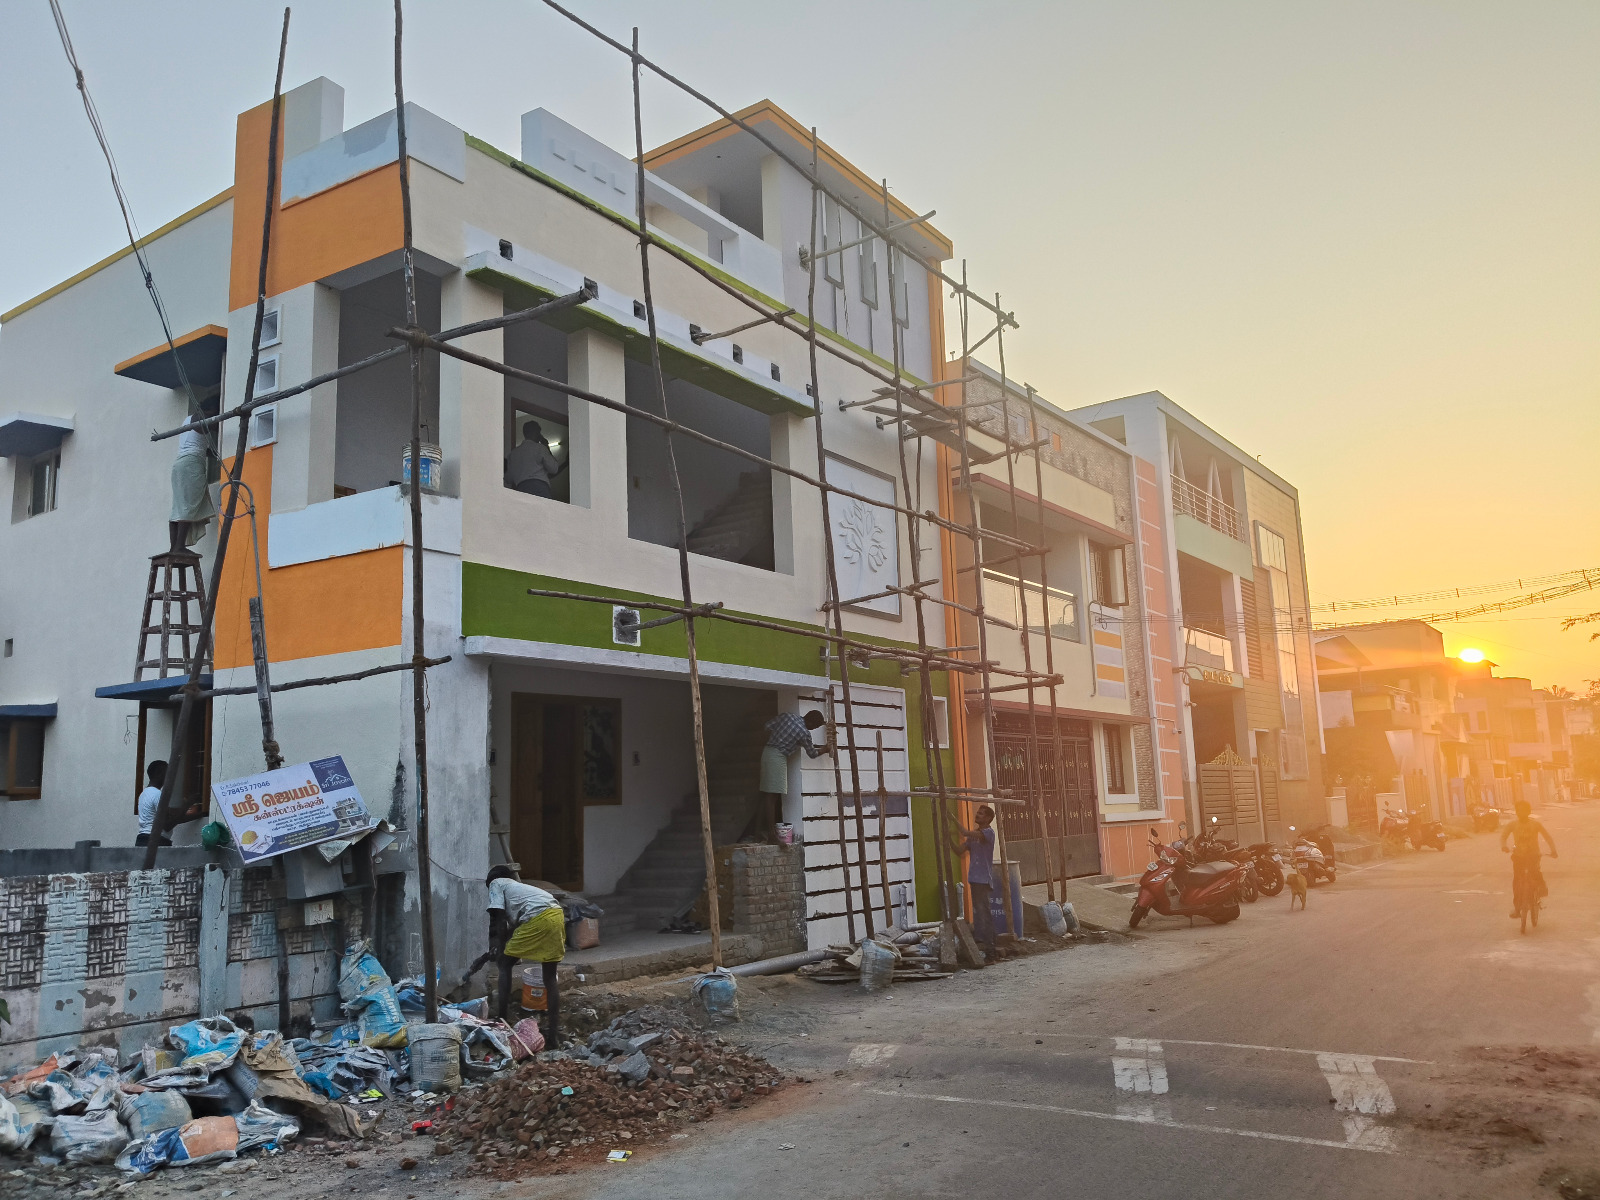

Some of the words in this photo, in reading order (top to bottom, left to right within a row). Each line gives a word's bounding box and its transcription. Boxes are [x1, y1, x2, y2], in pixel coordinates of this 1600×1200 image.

[227, 786, 249, 796] 78453
[248, 780, 271, 791] 77046
[261, 779, 321, 808] ஜெயம்
